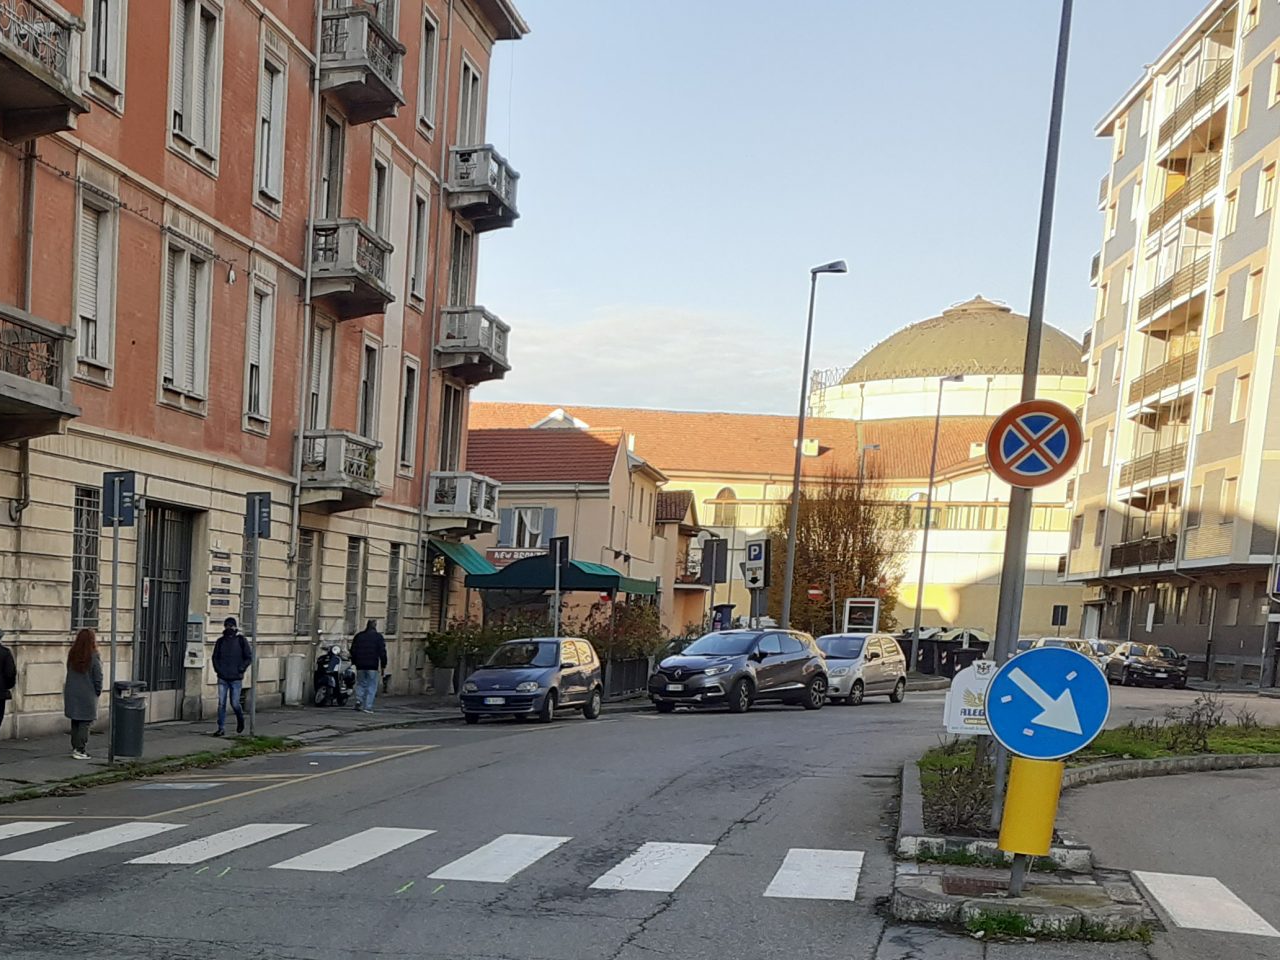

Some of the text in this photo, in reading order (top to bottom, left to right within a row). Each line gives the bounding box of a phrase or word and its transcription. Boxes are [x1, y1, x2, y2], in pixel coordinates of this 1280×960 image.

[494, 551, 512, 559] NEW
[750, 546, 760, 559] P
[960, 708, 985, 717] ALEG
